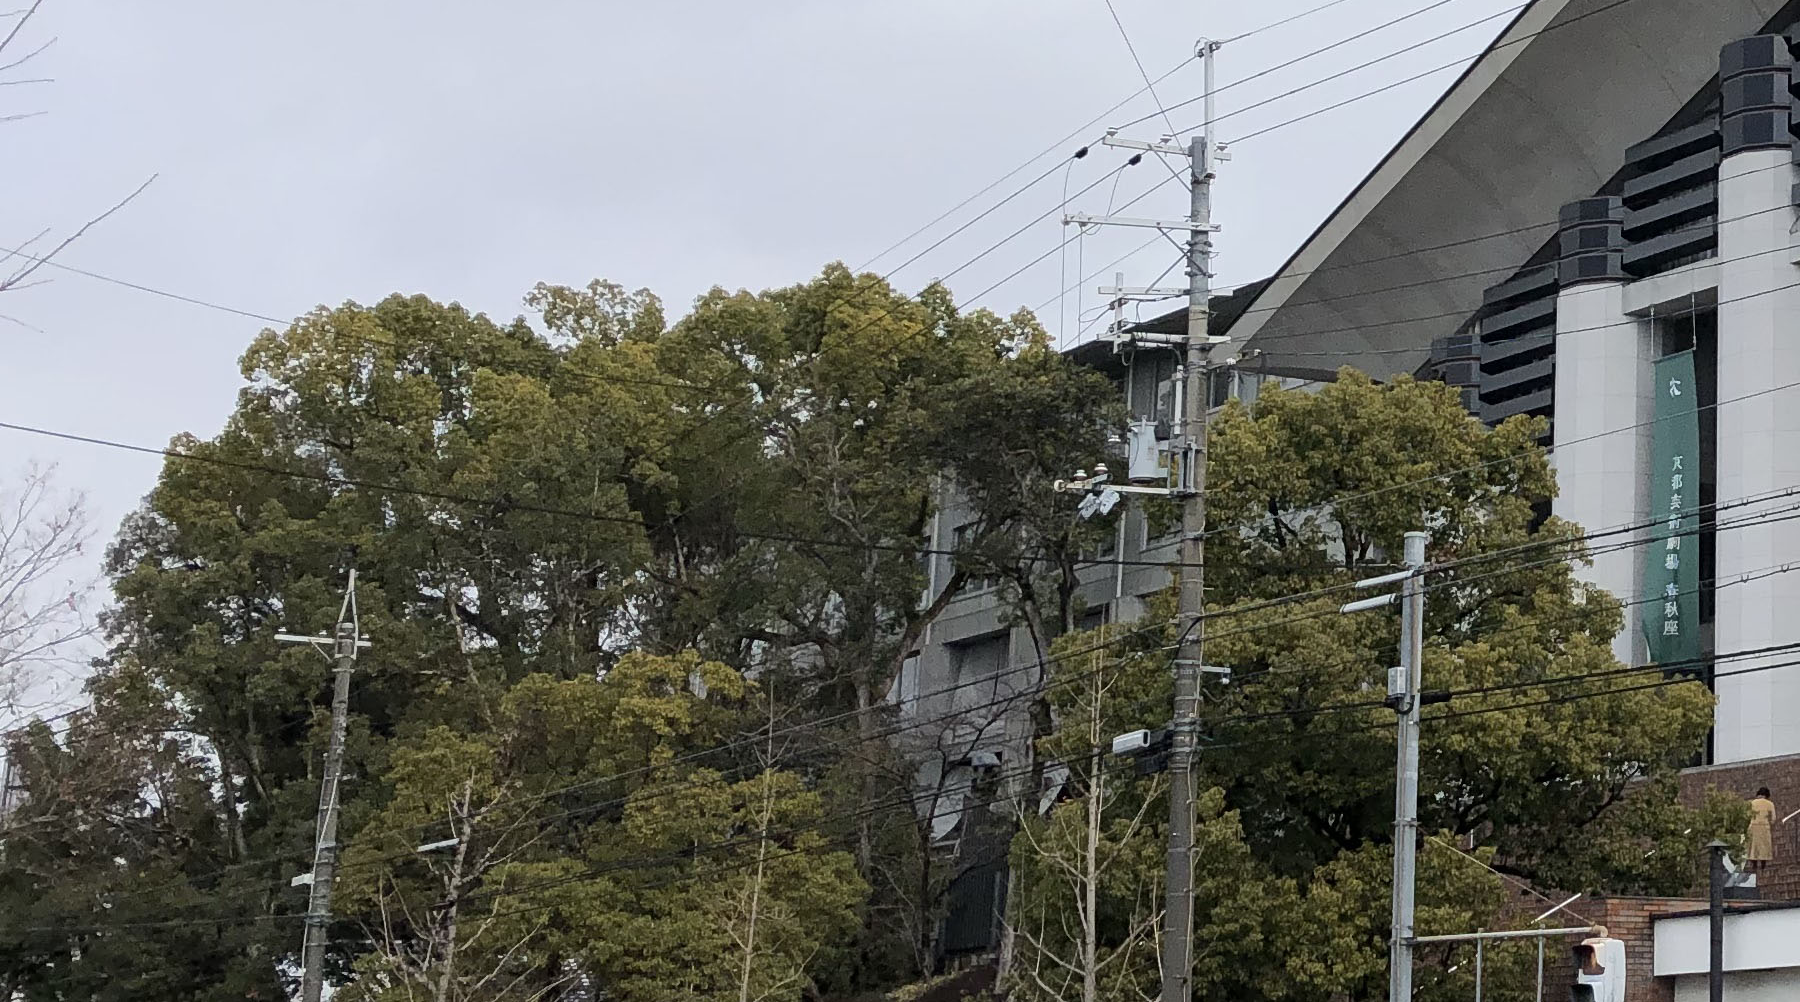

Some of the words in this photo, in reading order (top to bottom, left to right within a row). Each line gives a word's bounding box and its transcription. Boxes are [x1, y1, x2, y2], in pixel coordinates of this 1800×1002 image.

[1664, 455, 1683, 570] 京都芸術劇場
[1663, 582, 1680, 636] 春秋座
